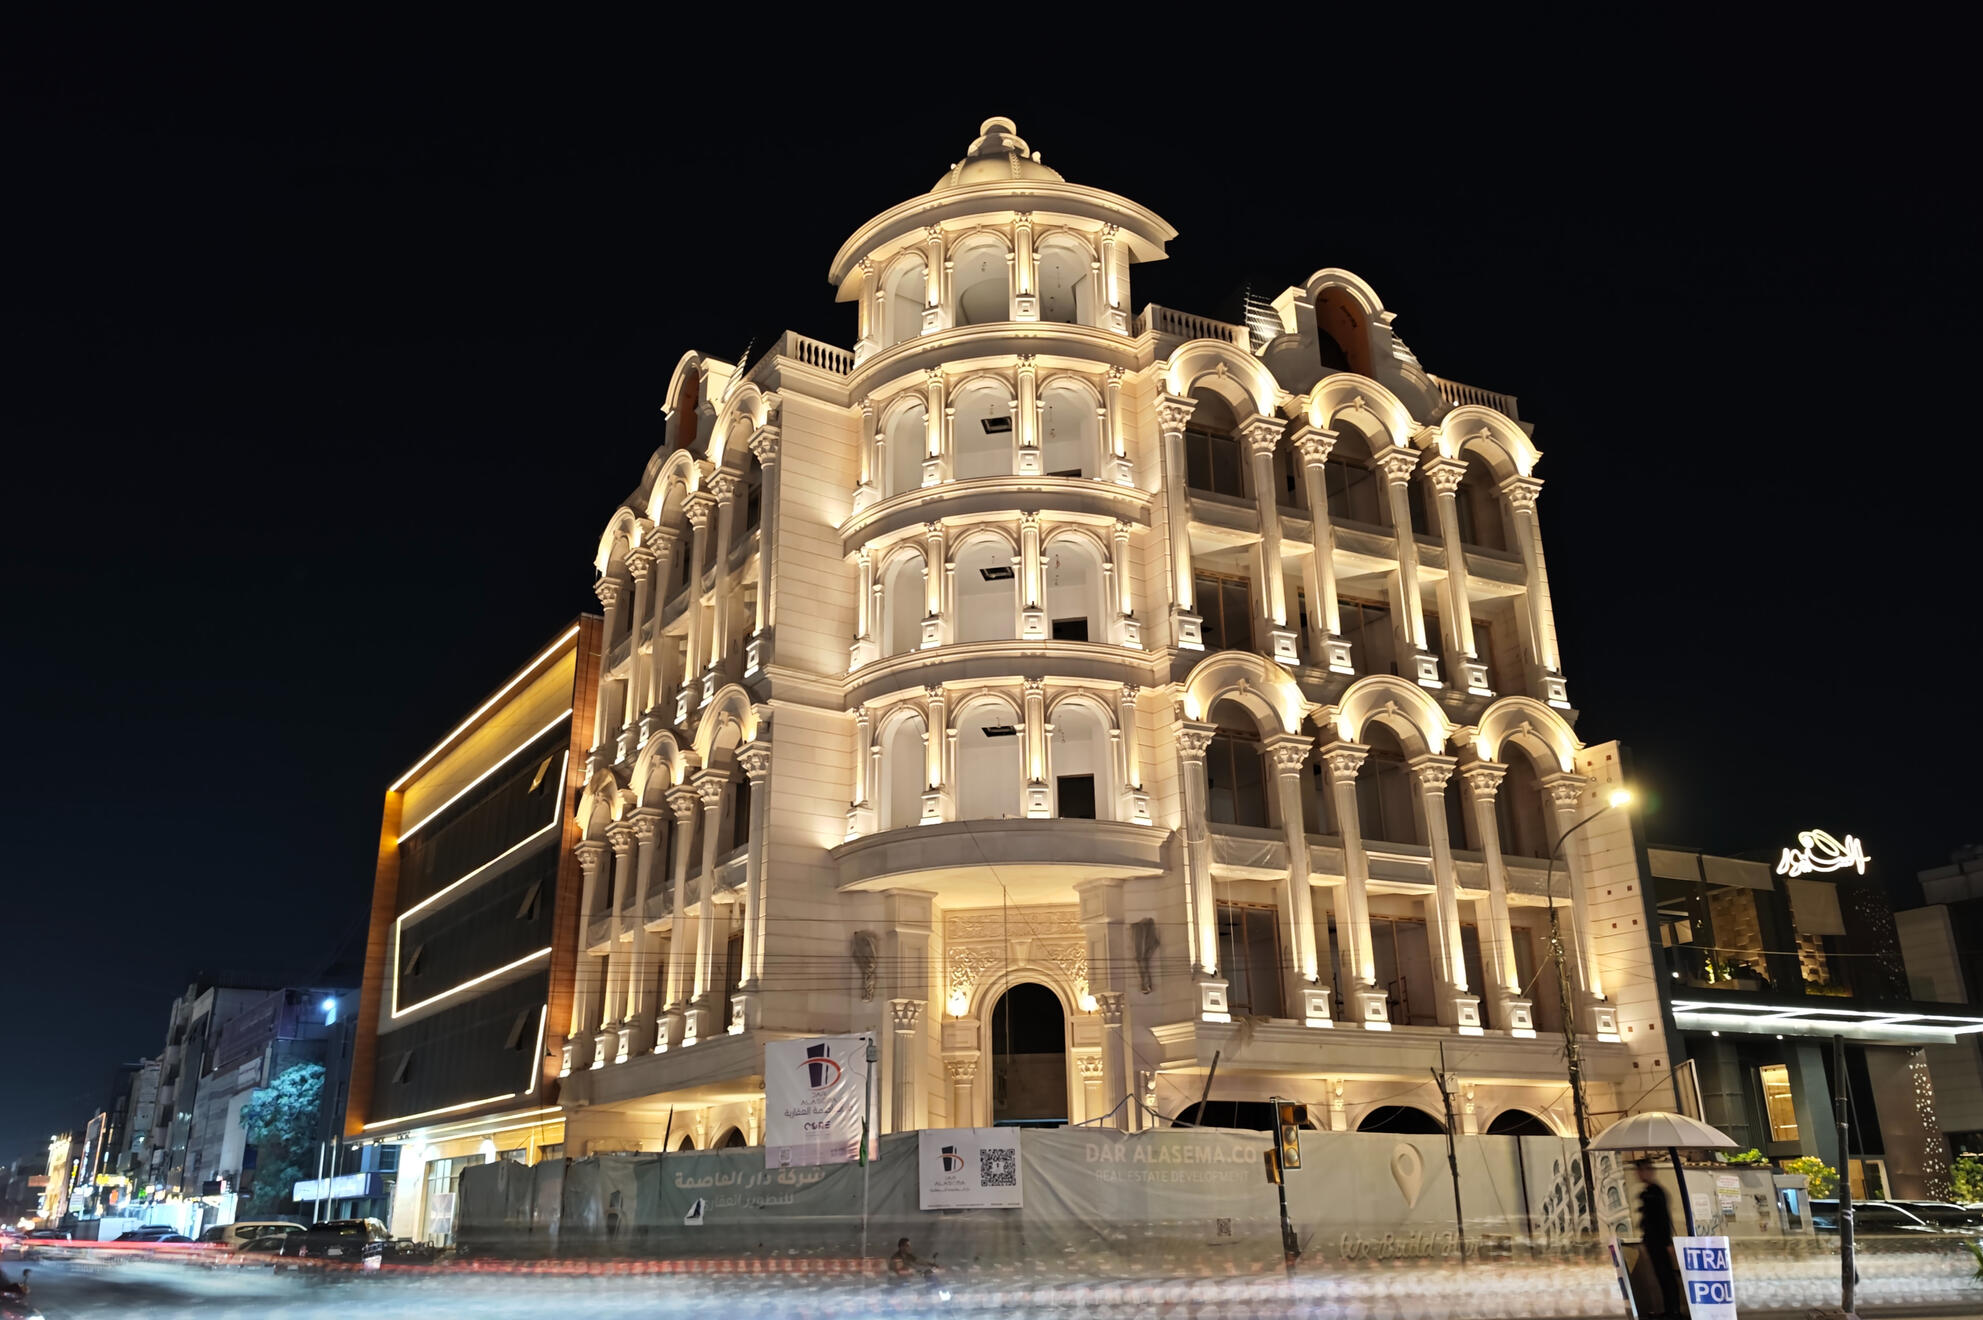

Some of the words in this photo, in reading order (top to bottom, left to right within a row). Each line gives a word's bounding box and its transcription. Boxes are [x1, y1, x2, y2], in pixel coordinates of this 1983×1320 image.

[1085, 1143, 1126, 1162] DAR
[1133, 1145, 1257, 1164] ALASEMA.CO
[674, 1171, 743, 1189] العاصمة
[745, 1171, 772, 1189] دار
[777, 1166, 826, 1188] شركة
[1096, 1169, 1122, 1183] REAL
[1128, 1170, 1168, 1183] ESTATE
[1687, 1248, 1729, 1270] TRA
